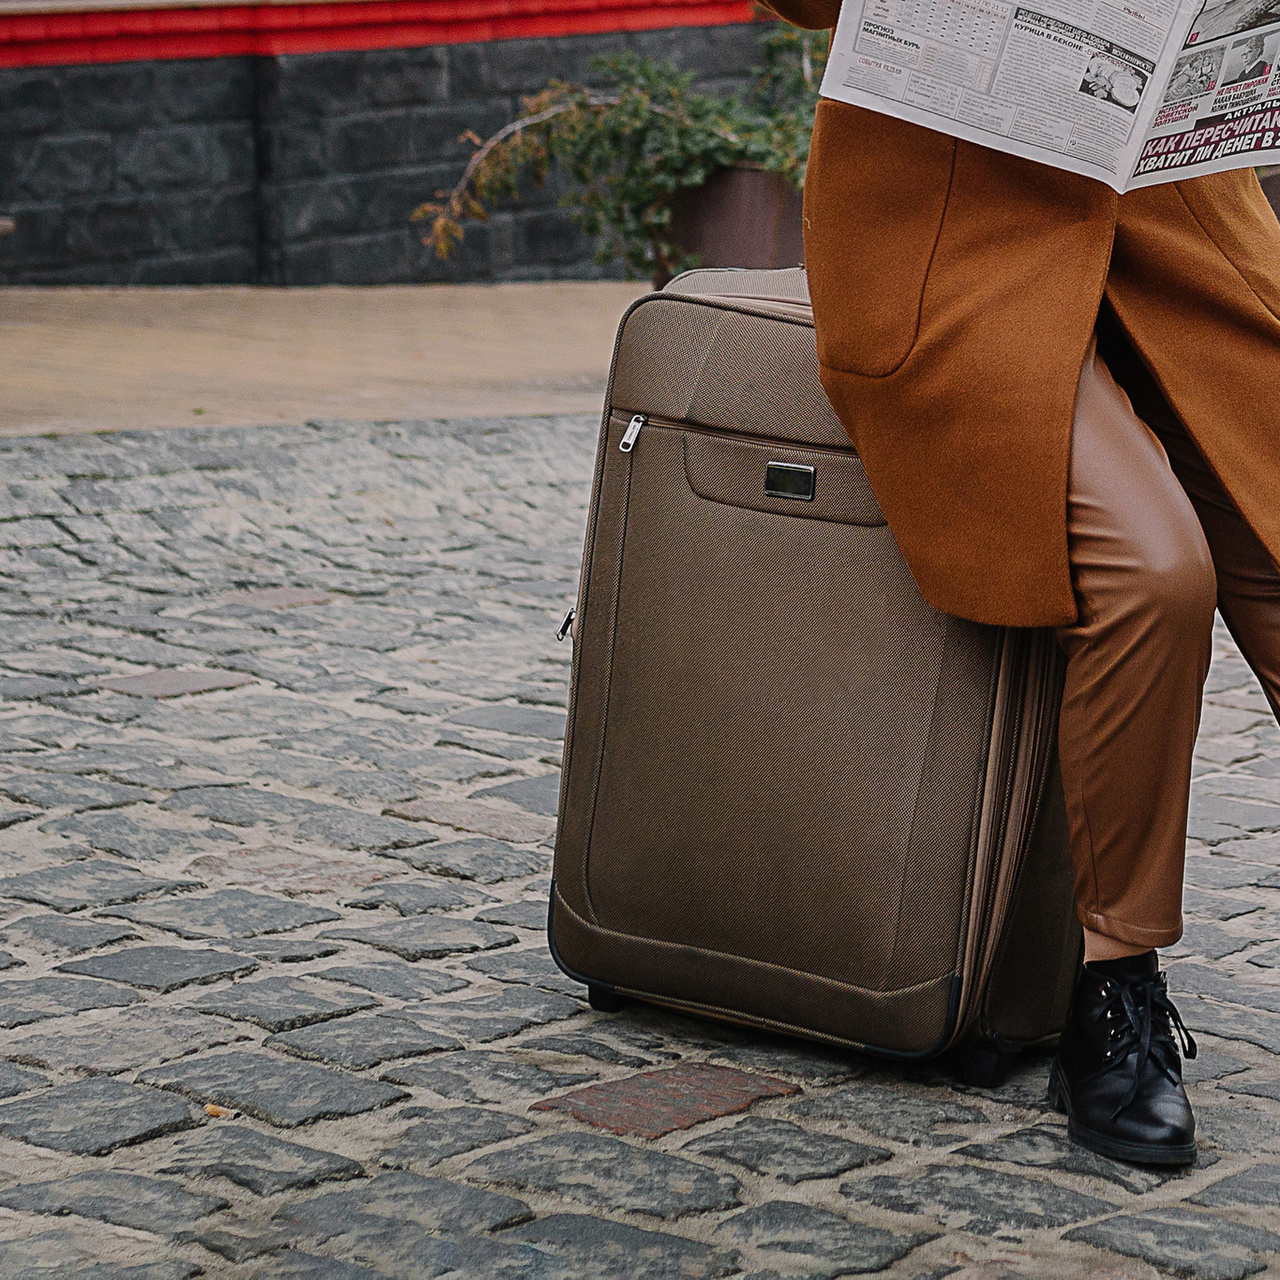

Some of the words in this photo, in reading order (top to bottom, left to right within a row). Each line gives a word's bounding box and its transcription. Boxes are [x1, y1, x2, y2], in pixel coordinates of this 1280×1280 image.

[1124, 6, 1146, 20] РЫБЫ
[864, 21, 894, 35] ПРОГНОЗ
[862, 27, 902, 44] МАГНИТНЫХ
[903, 39, 921, 50] БУРЬ
[1014, 22, 1045, 37] КУРИЦА
[1053, 36, 1084, 52] БЕКОНЕ
[1214, 94, 1233, 105] КАКАЯ
[1232, 88, 1257, 101] БАБУШКА
[1155, 104, 1199, 122] СОВЕТСКОЙ
[1157, 101, 1192, 116] ИСТОРИЯ
[1152, 113, 1189, 129] ЗОЛУШКИ
[1134, 150, 1196, 175] ХВАТИТ
[1193, 146, 1216, 162] ЛИ
[1212, 133, 1261, 159] ДЕНЕГ
[1262, 132, 1275, 148] В
[1142, 137, 1178, 160] КАК
